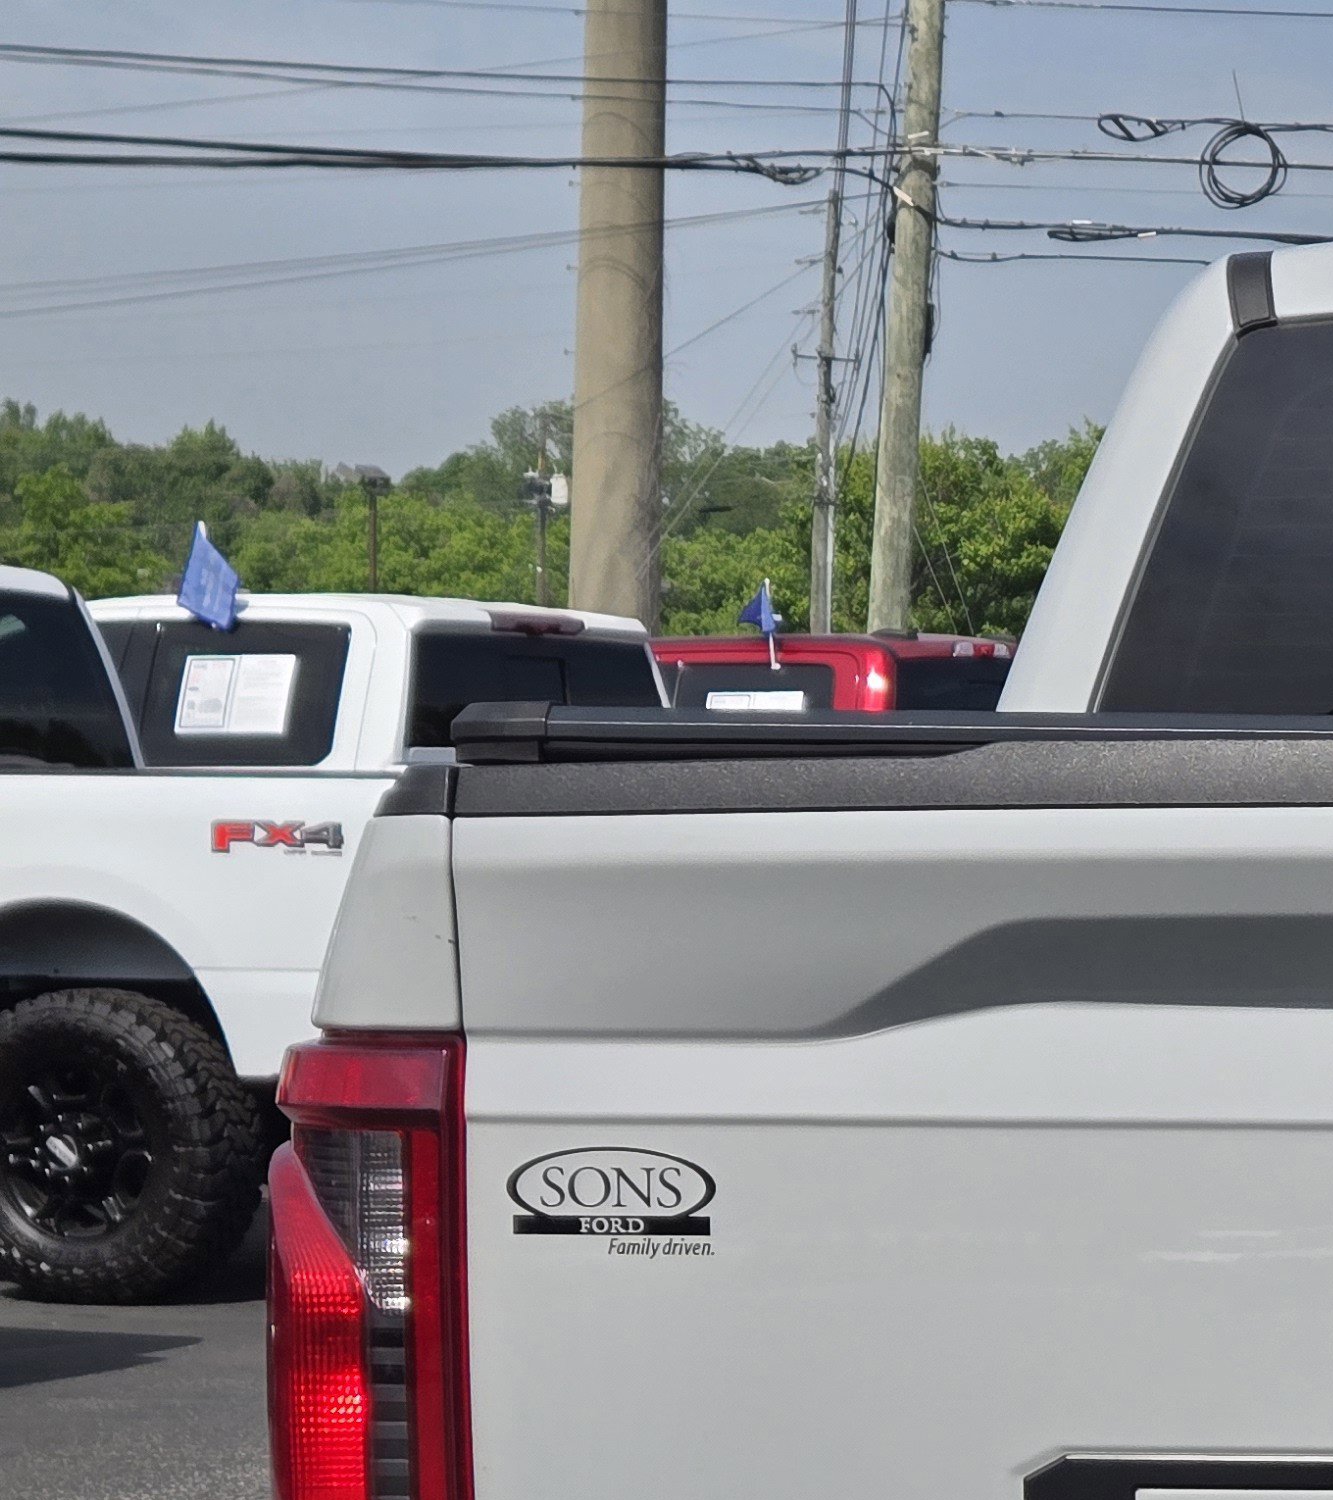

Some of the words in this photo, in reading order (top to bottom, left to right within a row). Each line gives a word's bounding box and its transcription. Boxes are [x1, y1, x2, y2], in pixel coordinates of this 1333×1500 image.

[211, 819, 344, 853] FX4
[540, 1166, 682, 1208] SONS
[578, 1217, 645, 1233] FORD
[607, 1238, 660, 1259] Family
[662, 1239, 716, 1256] driven.
